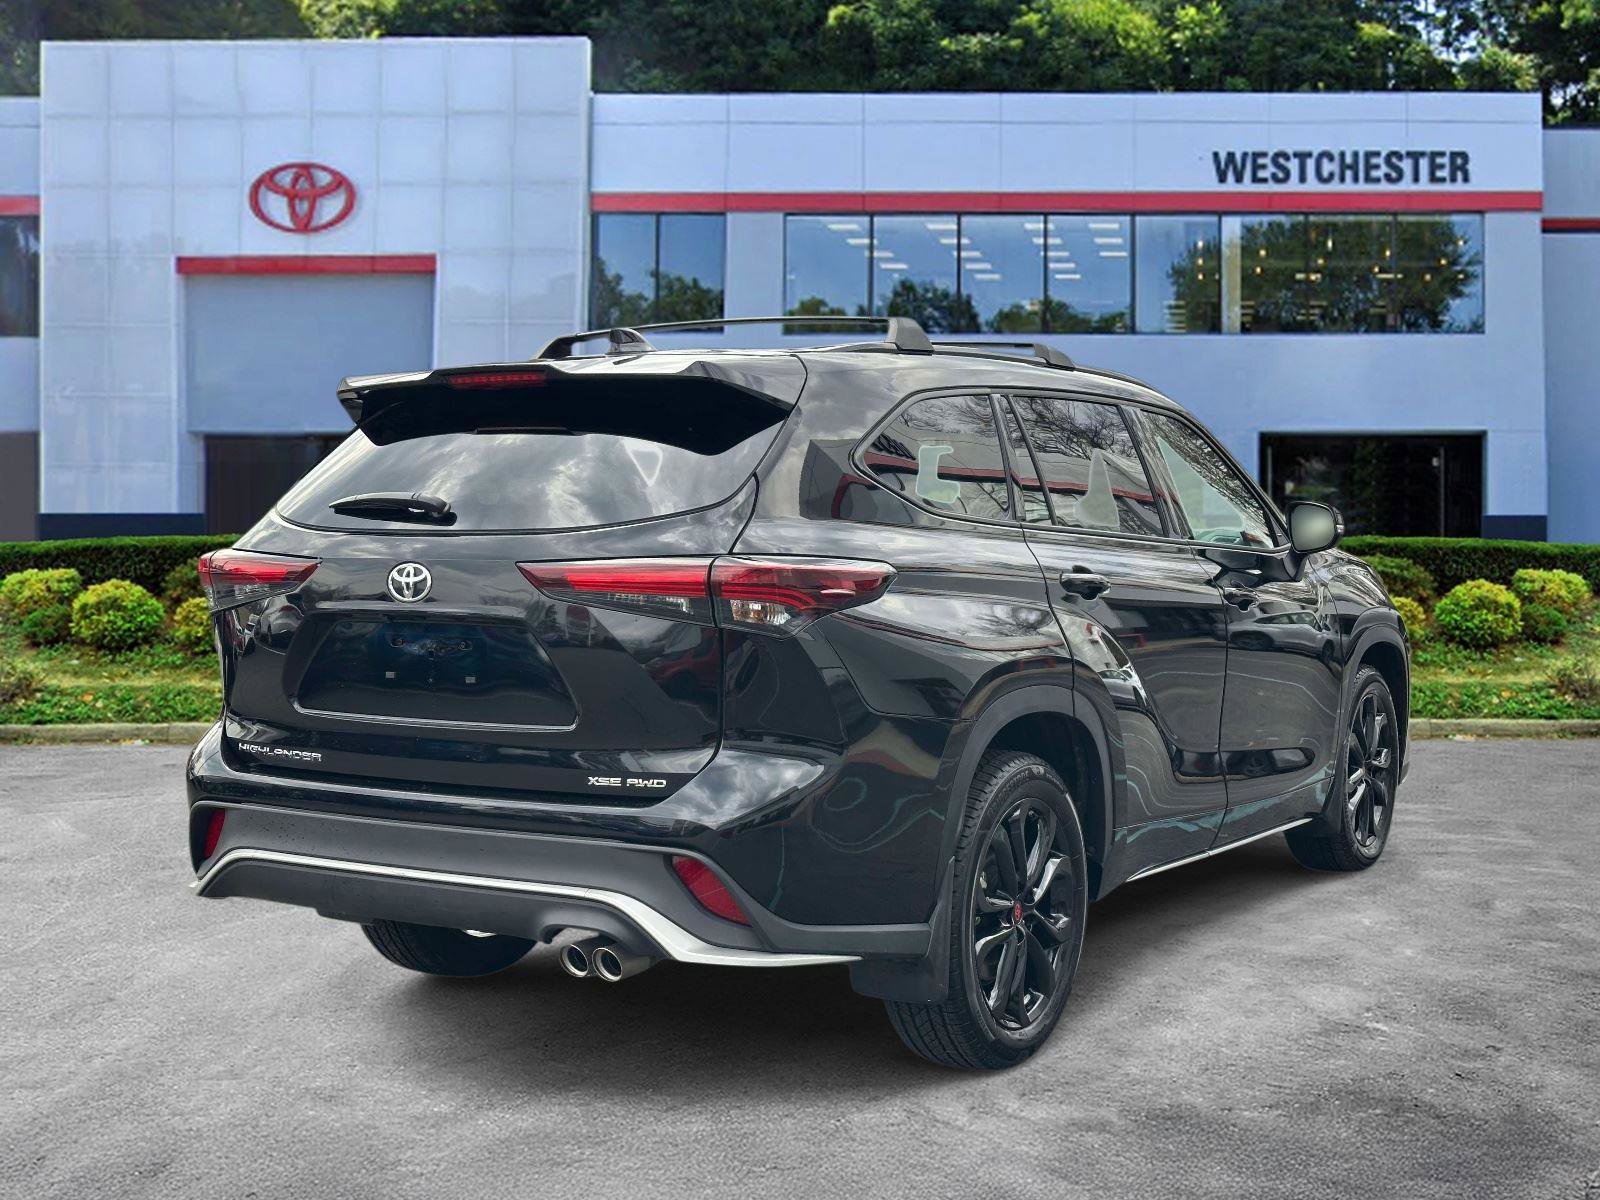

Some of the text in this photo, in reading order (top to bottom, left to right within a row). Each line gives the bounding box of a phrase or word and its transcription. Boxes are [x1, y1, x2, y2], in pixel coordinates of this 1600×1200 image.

[1212, 150, 1471, 184] WESTCHESTER
[237, 742, 322, 762] HIGHLANDER
[587, 776, 667, 788] XSE AWD
